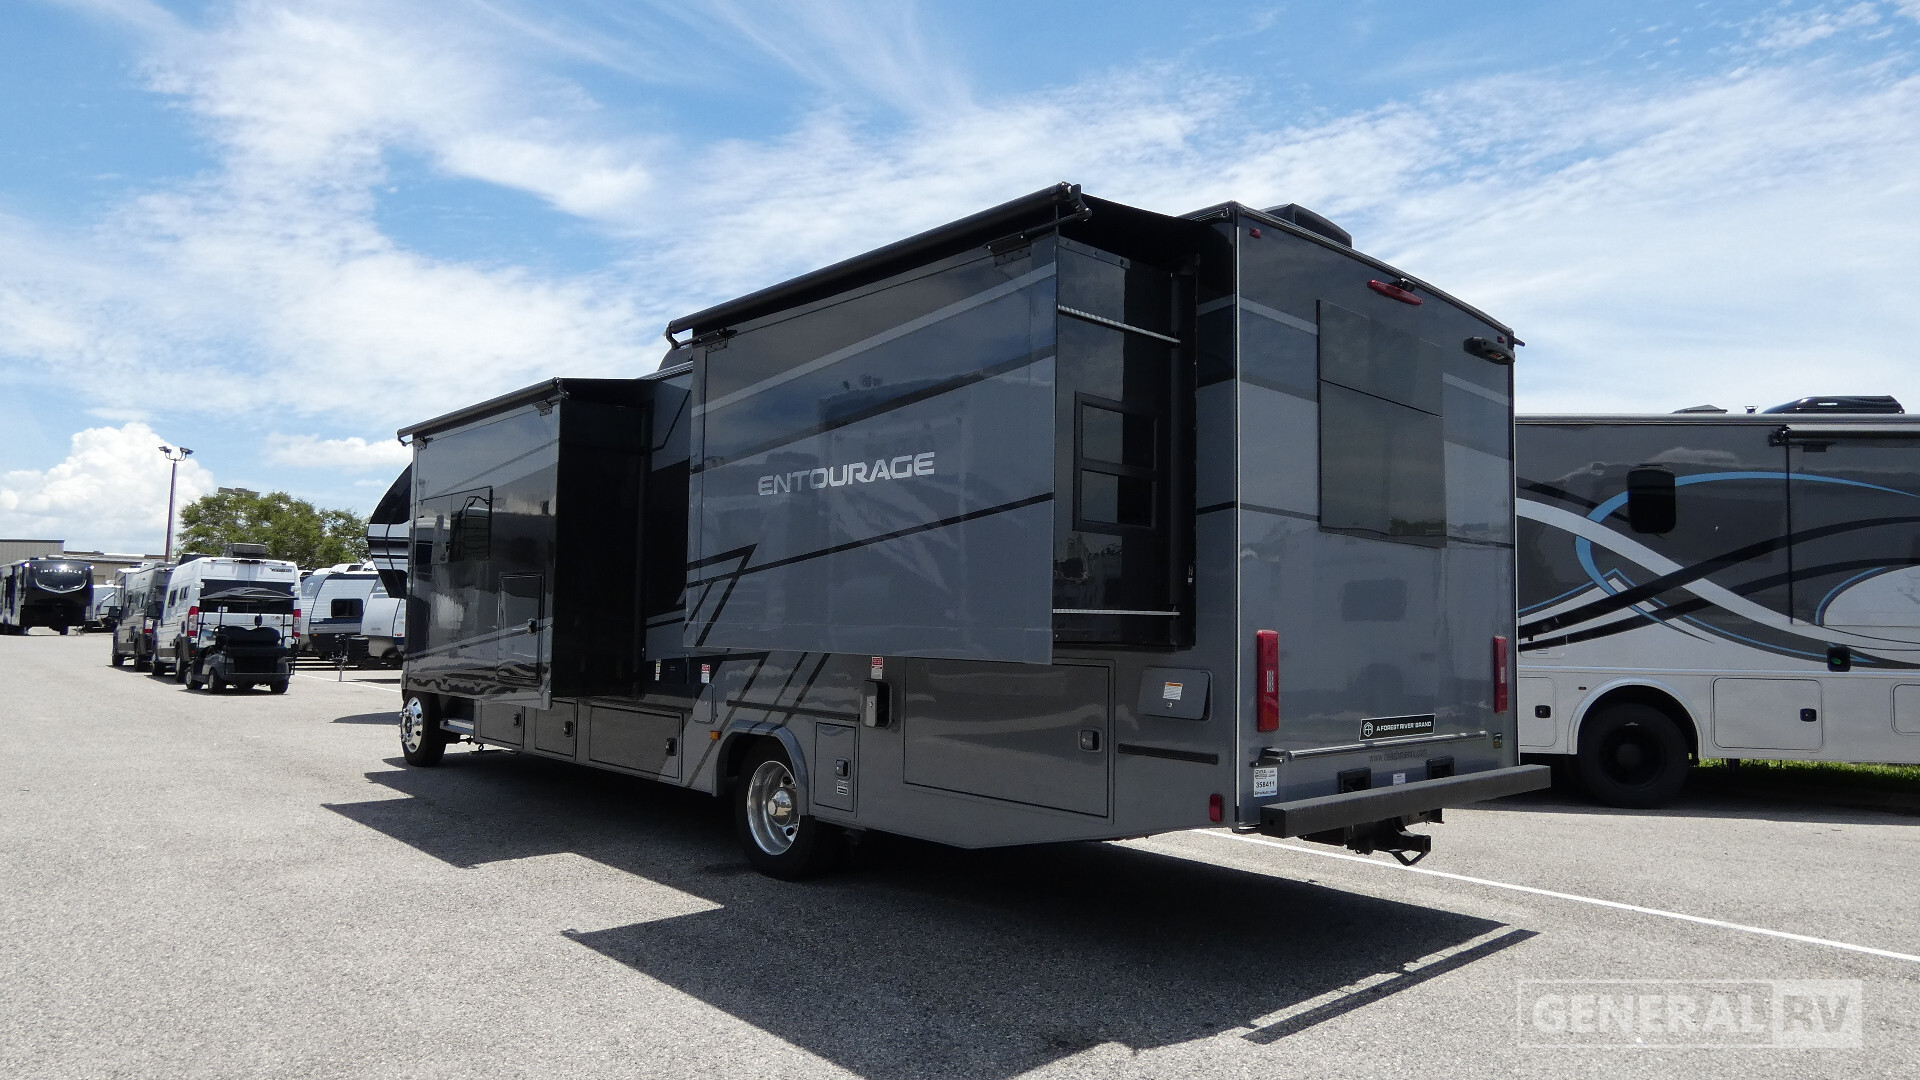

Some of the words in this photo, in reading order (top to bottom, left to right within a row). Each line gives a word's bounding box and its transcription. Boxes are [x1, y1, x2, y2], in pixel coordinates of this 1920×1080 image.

[757, 451, 935, 496] ENTOURAGE
[1381, 723, 1400, 731] FOREST
[1400, 722, 1414, 730] RIVER
